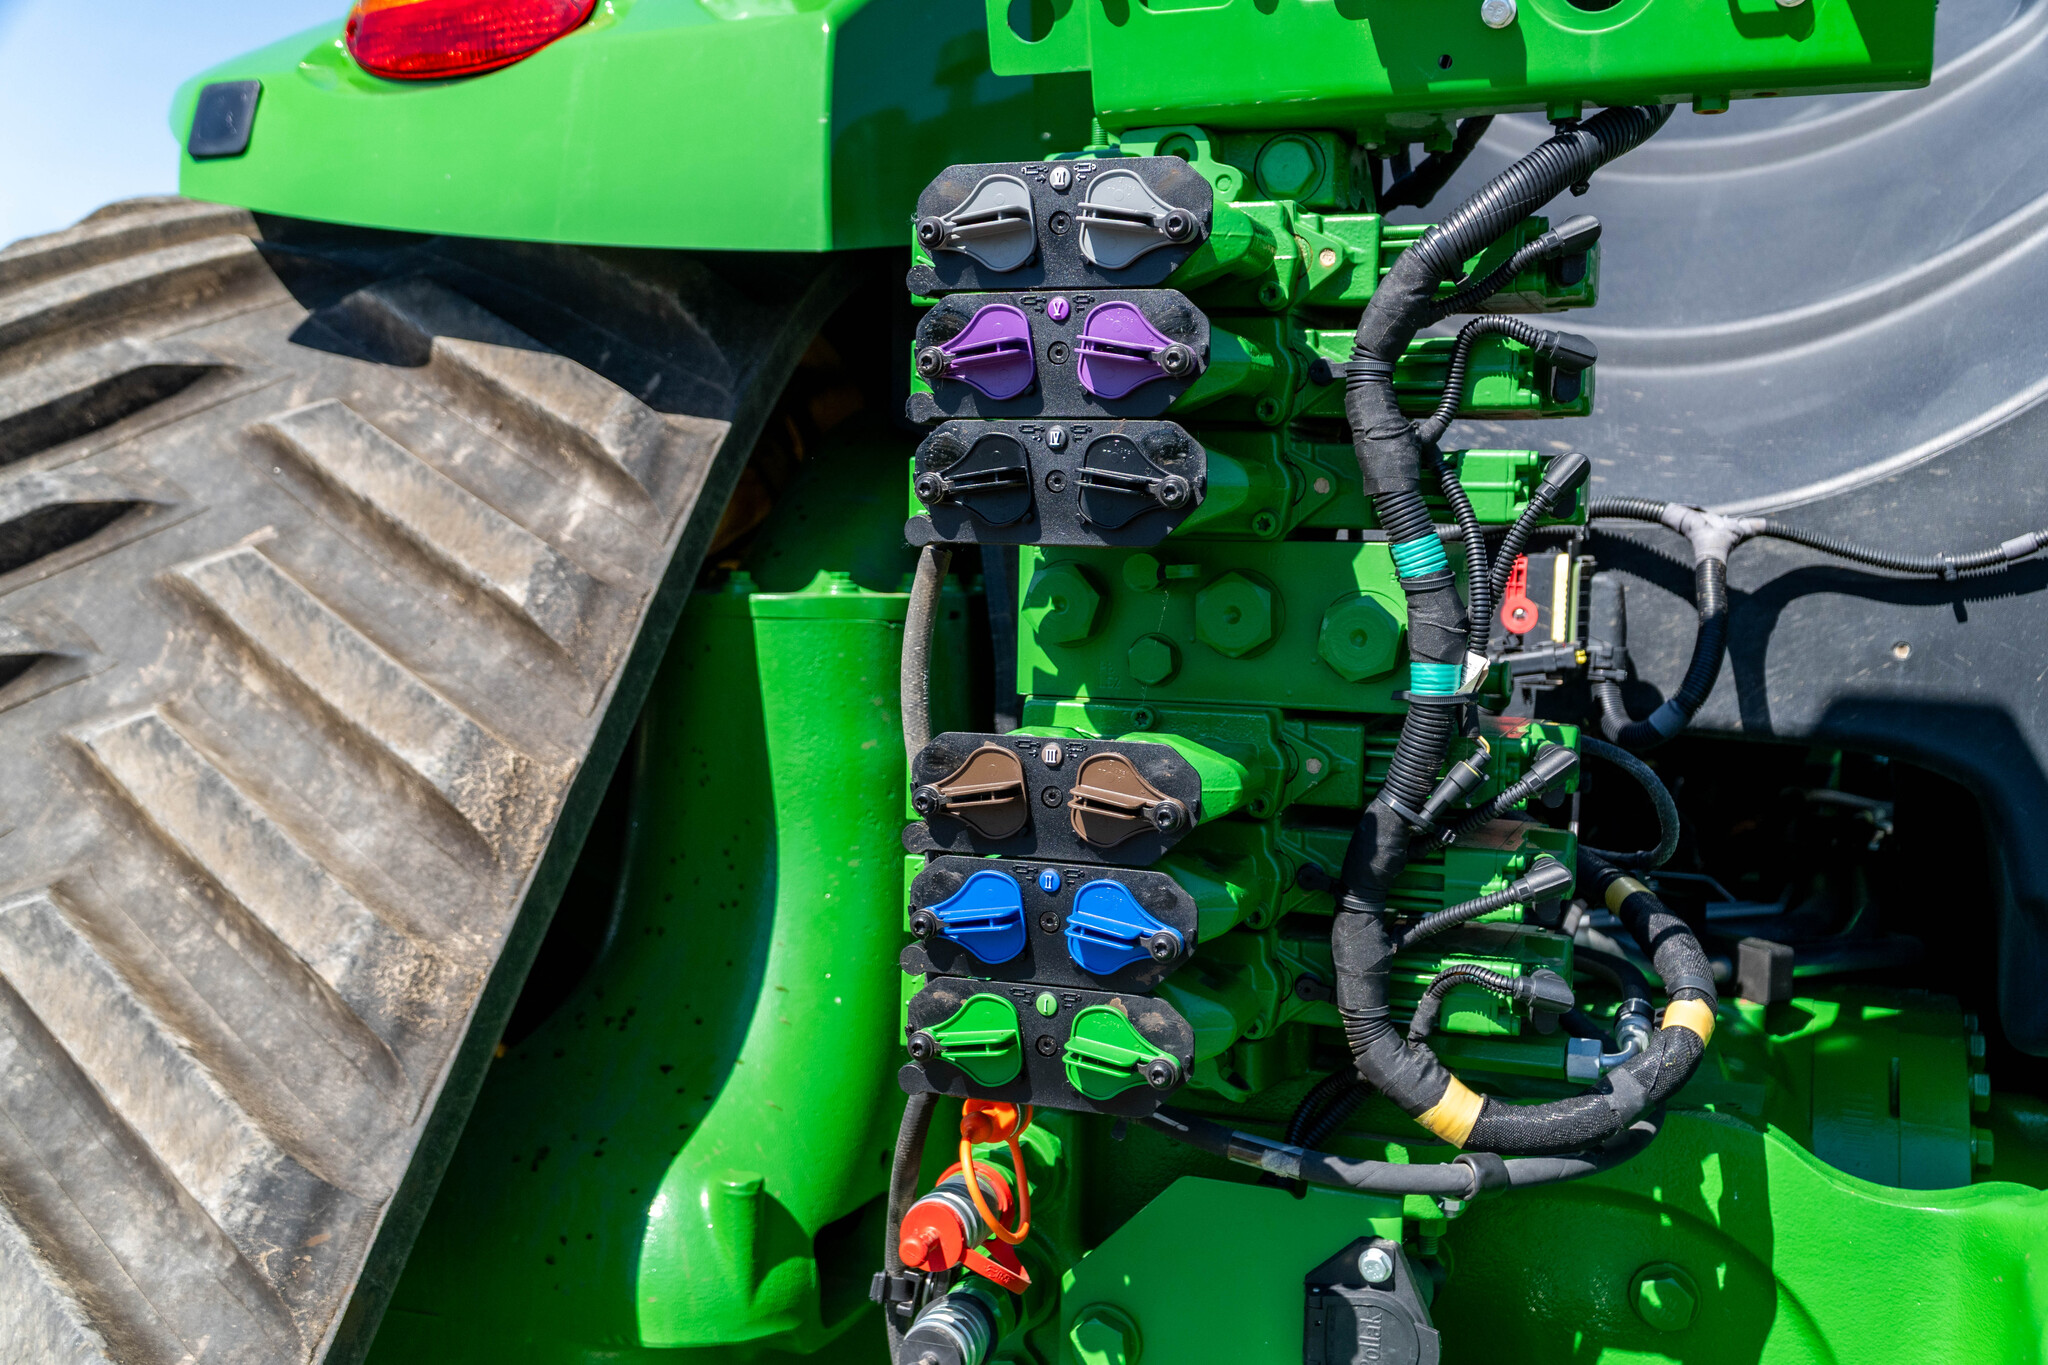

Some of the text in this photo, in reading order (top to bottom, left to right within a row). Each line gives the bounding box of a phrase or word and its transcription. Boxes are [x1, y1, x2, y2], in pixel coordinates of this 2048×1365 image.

[1053, 172, 1065, 186] VI
[1052, 301, 1064, 316] V
[1049, 431, 1061, 446] IV
[1045, 749, 1057, 764] III
[1044, 875, 1053, 889] II
